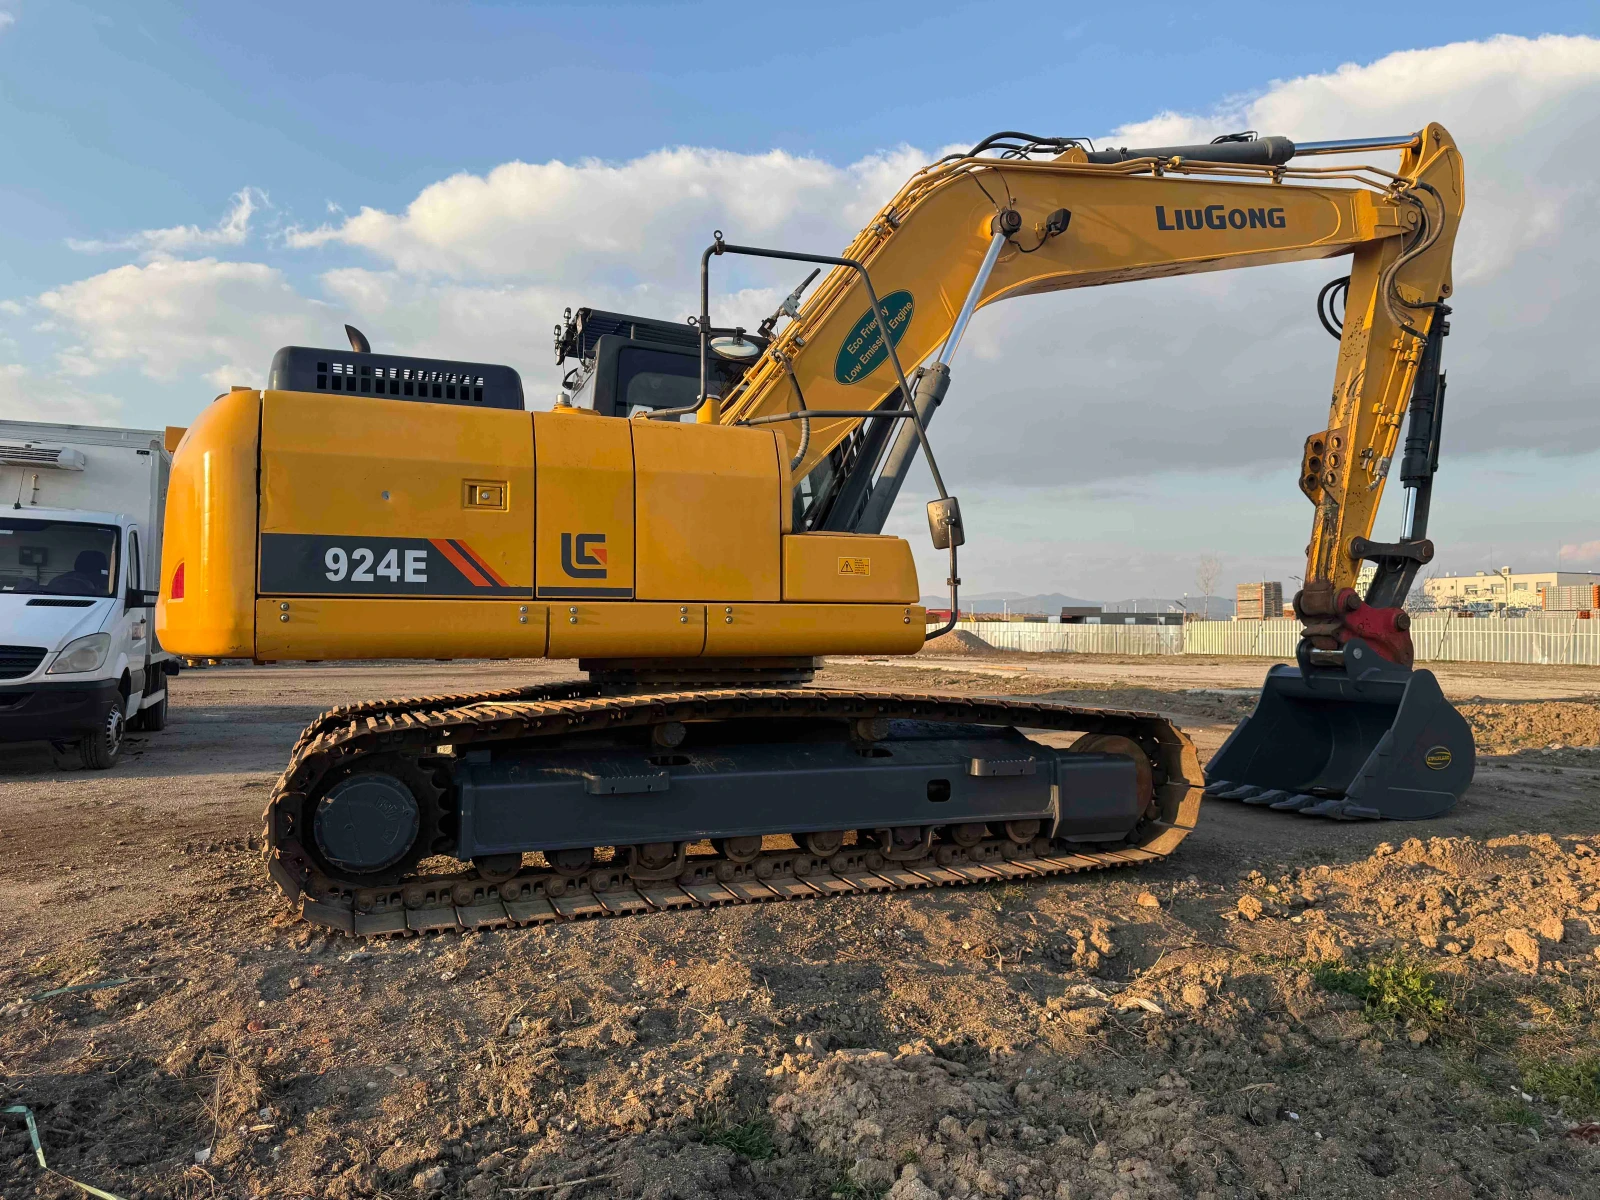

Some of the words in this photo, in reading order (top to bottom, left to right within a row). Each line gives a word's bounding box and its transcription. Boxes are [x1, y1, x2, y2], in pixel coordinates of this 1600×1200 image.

[844, 362, 862, 382] Low
[888, 301, 913, 330] Engine
[846, 337, 863, 355] Eco
[324, 546, 428, 583] 924E
